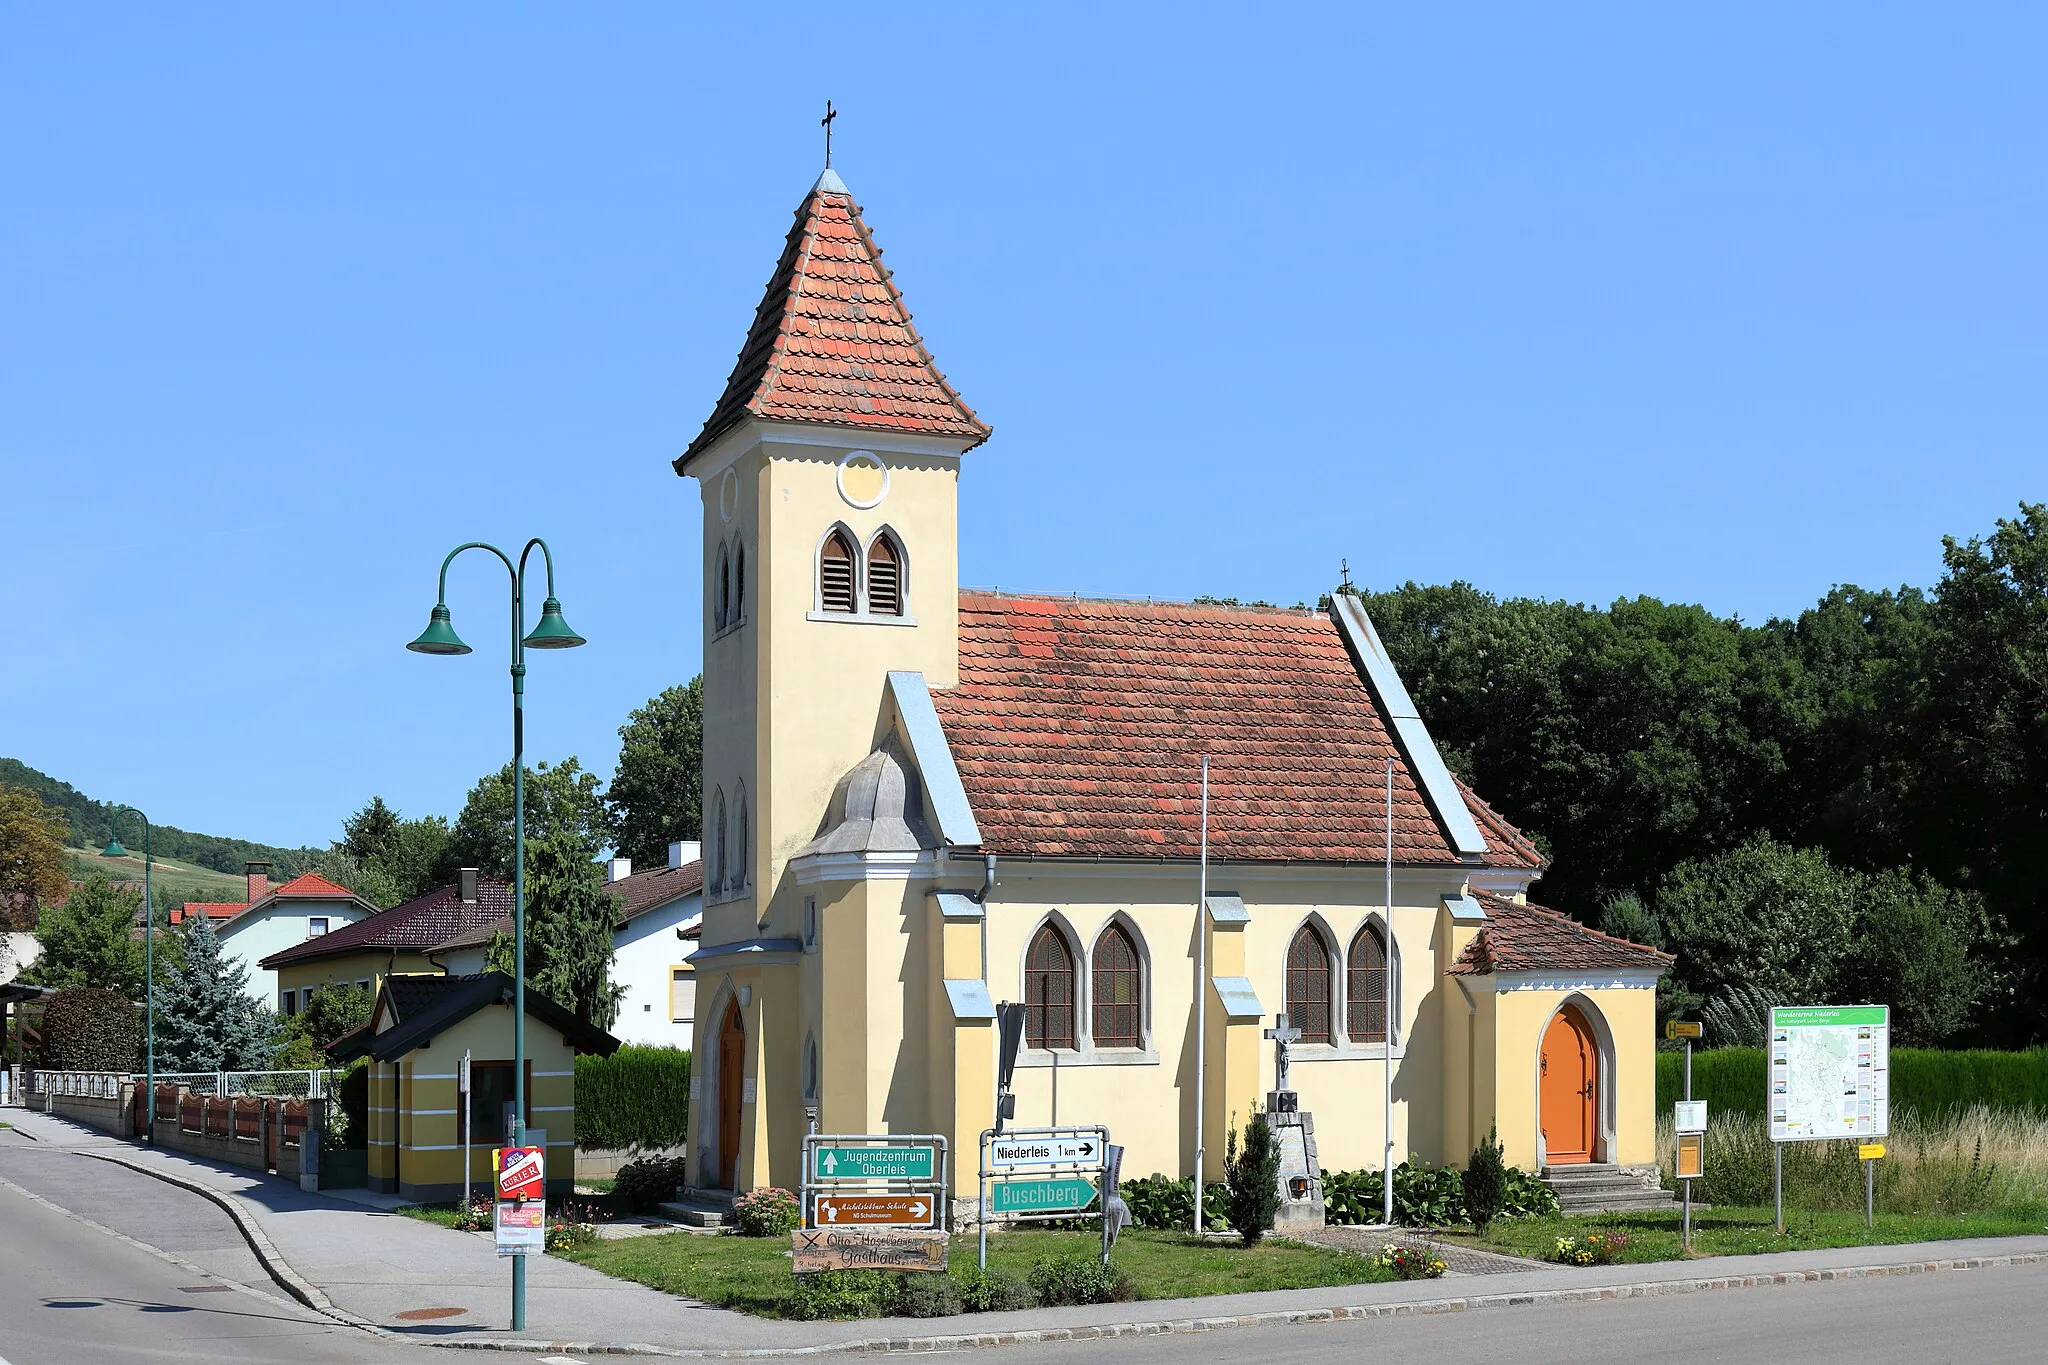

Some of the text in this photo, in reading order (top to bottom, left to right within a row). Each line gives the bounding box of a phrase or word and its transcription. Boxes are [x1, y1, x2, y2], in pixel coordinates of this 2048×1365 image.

[1669, 1022, 1676, 1037] H
[843, 1150, 926, 1164] Jugendzentrum
[997, 1144, 1076, 1159] Niederleis 1 km
[862, 1163, 907, 1175] Oberleis
[503, 1166, 538, 1188] KURIER
[1002, 1184, 1079, 1206] Buschberg
[886, 1201, 908, 1211] Schule
[827, 1233, 851, 1247] Otto
[840, 1248, 901, 1268] Gasthaus
